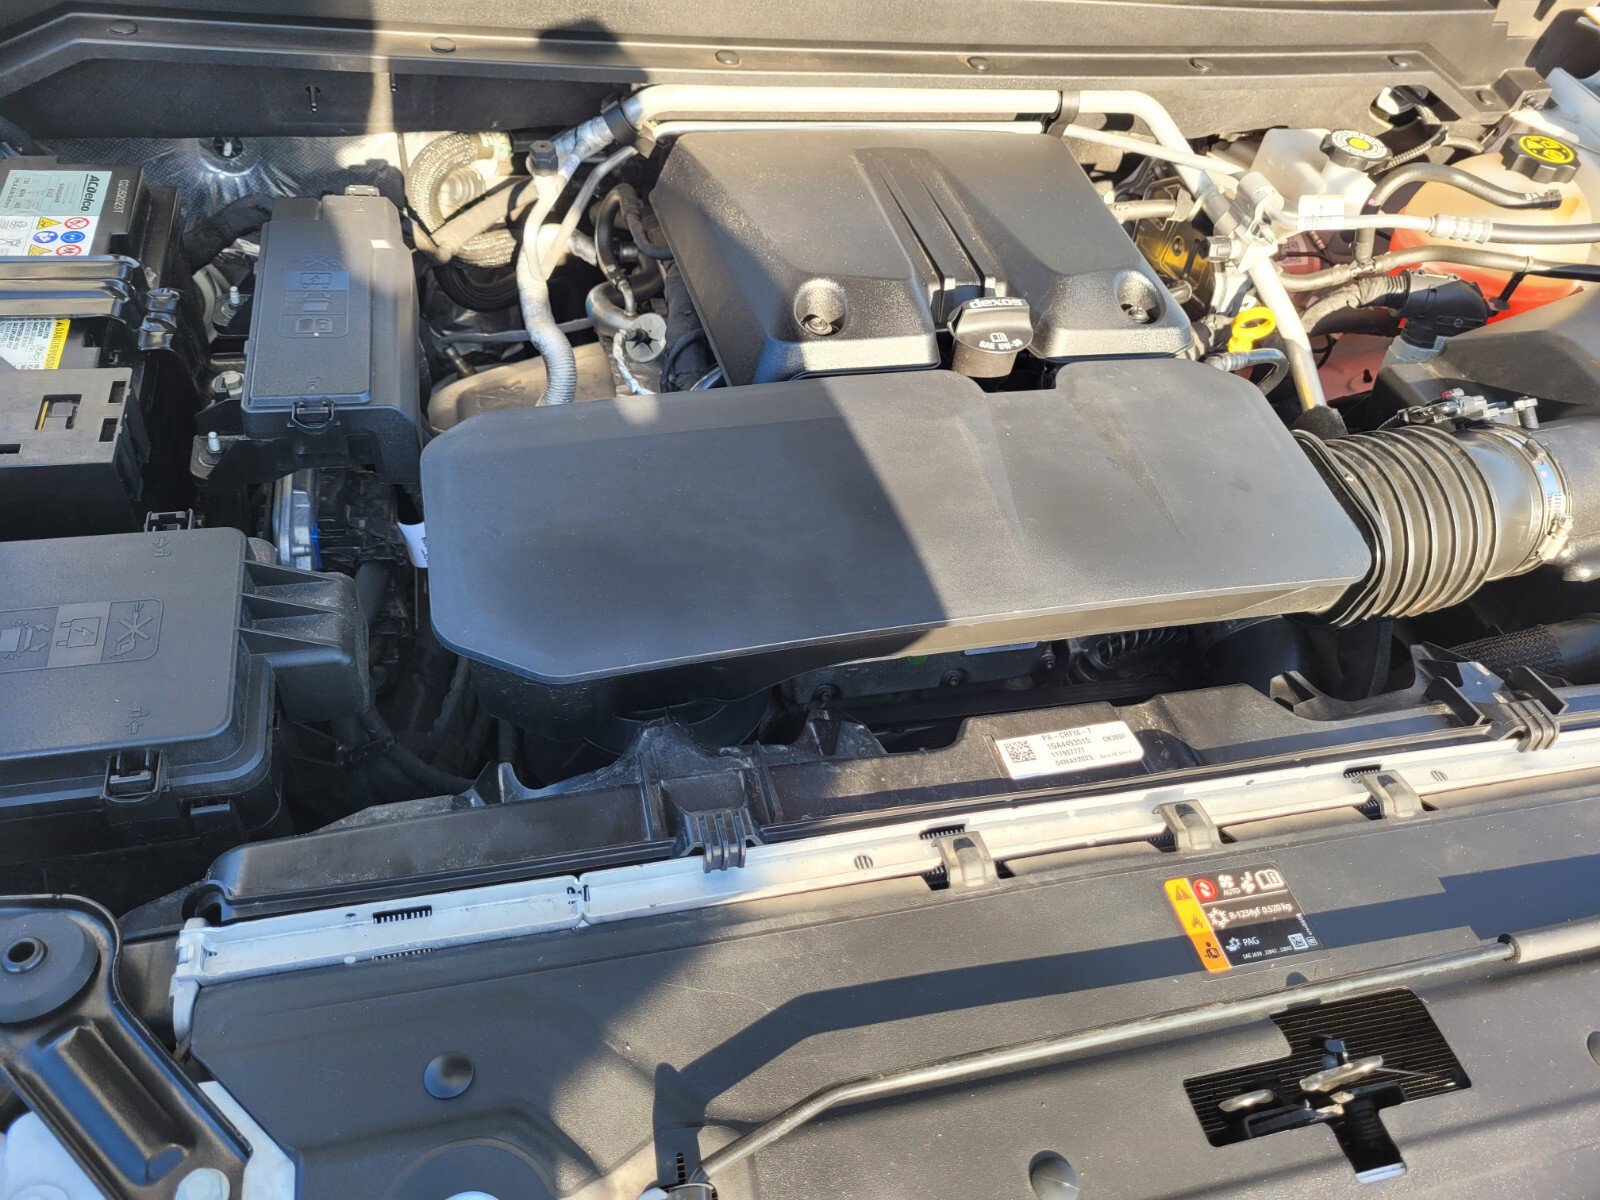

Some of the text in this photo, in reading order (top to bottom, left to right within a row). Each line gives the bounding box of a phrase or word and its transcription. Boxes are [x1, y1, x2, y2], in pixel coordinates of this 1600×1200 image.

[81, 175, 100, 211] ACDelco
[969, 299, 1023, 309] dexos
[979, 340, 995, 349] SAE
[1223, 888, 1241, 896] AUTO
[1242, 936, 1260, 946] PAG
